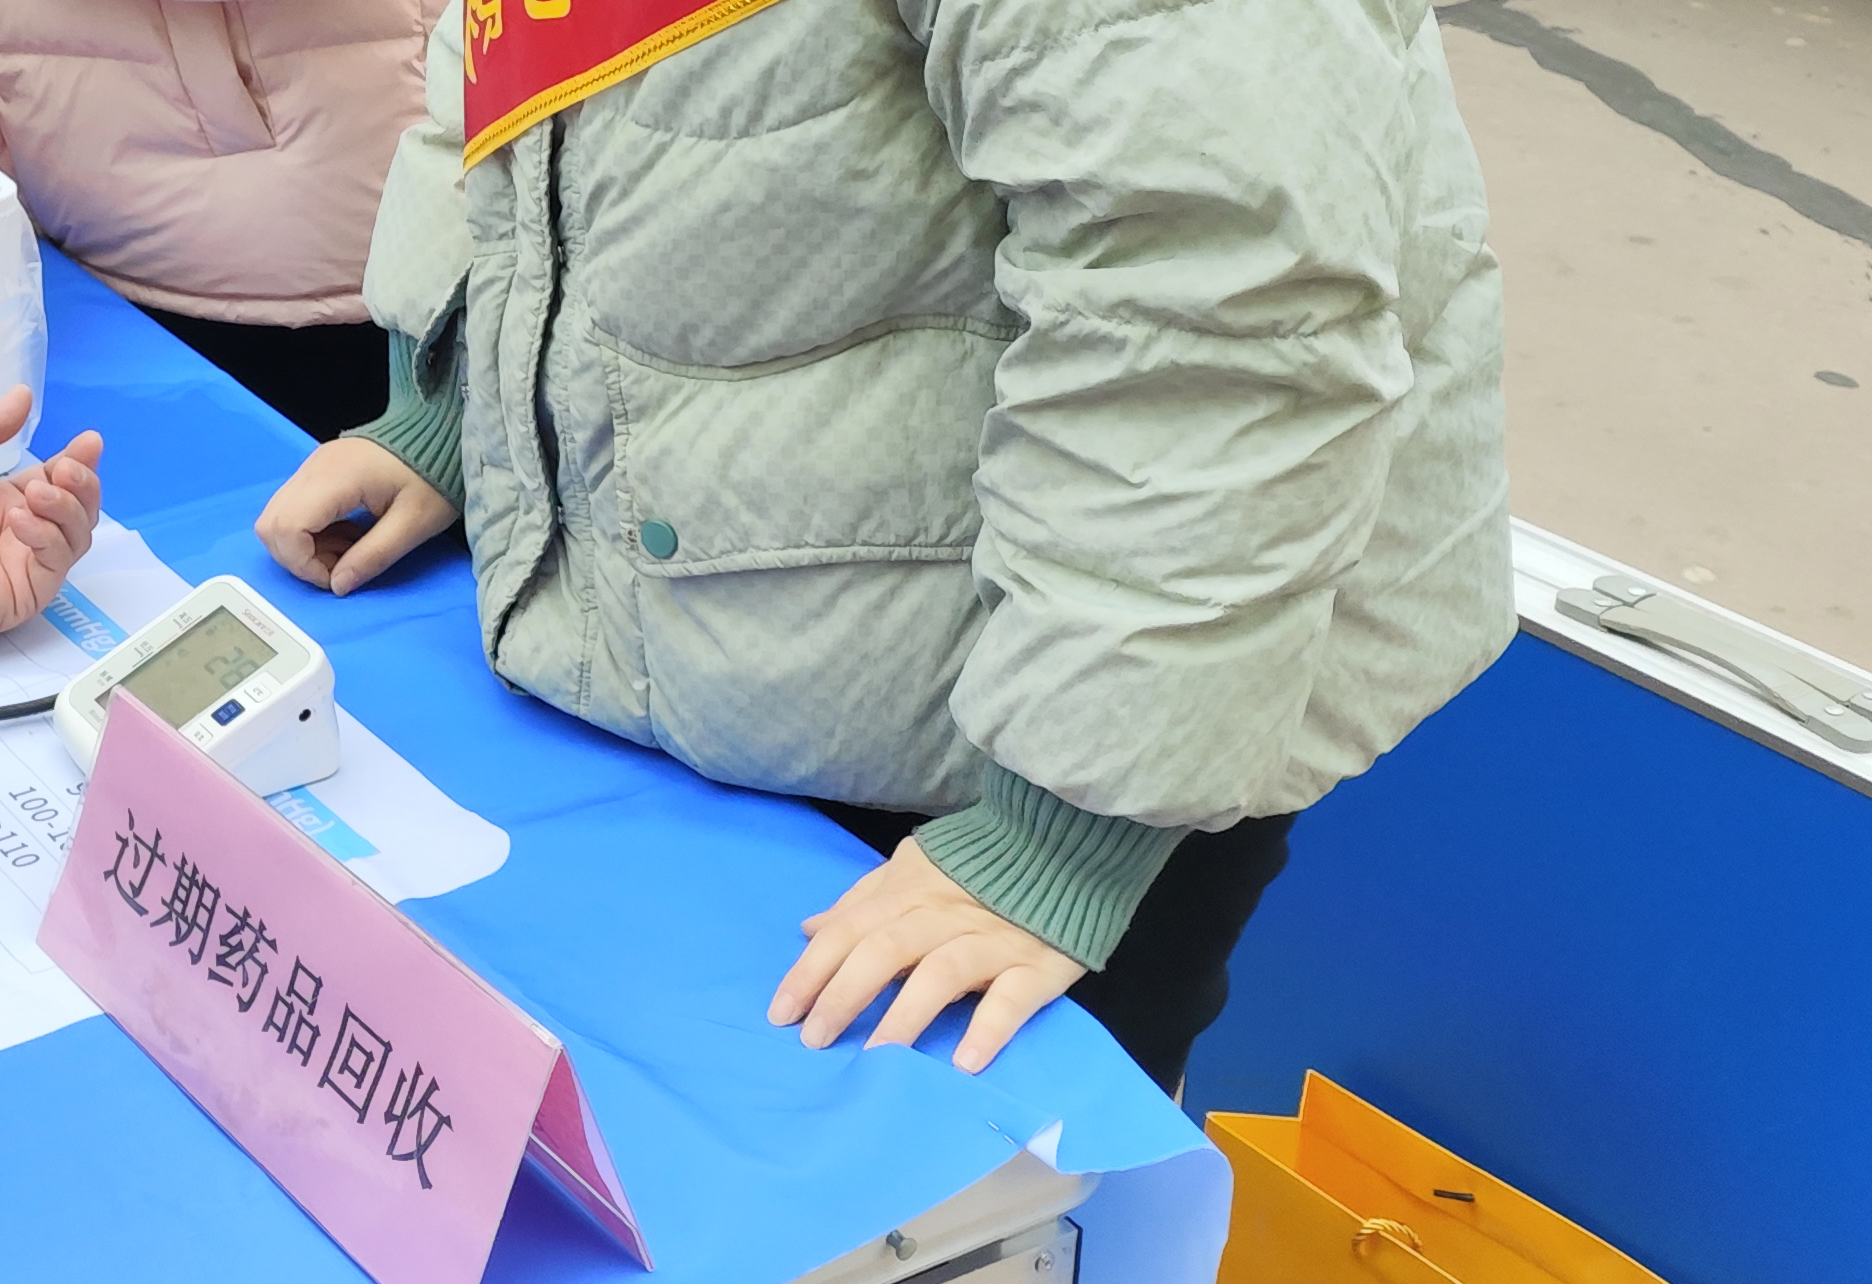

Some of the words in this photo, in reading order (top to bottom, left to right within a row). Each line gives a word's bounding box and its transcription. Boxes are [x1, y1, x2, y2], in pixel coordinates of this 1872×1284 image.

[102, 807, 455, 1191] 过期药品回收
